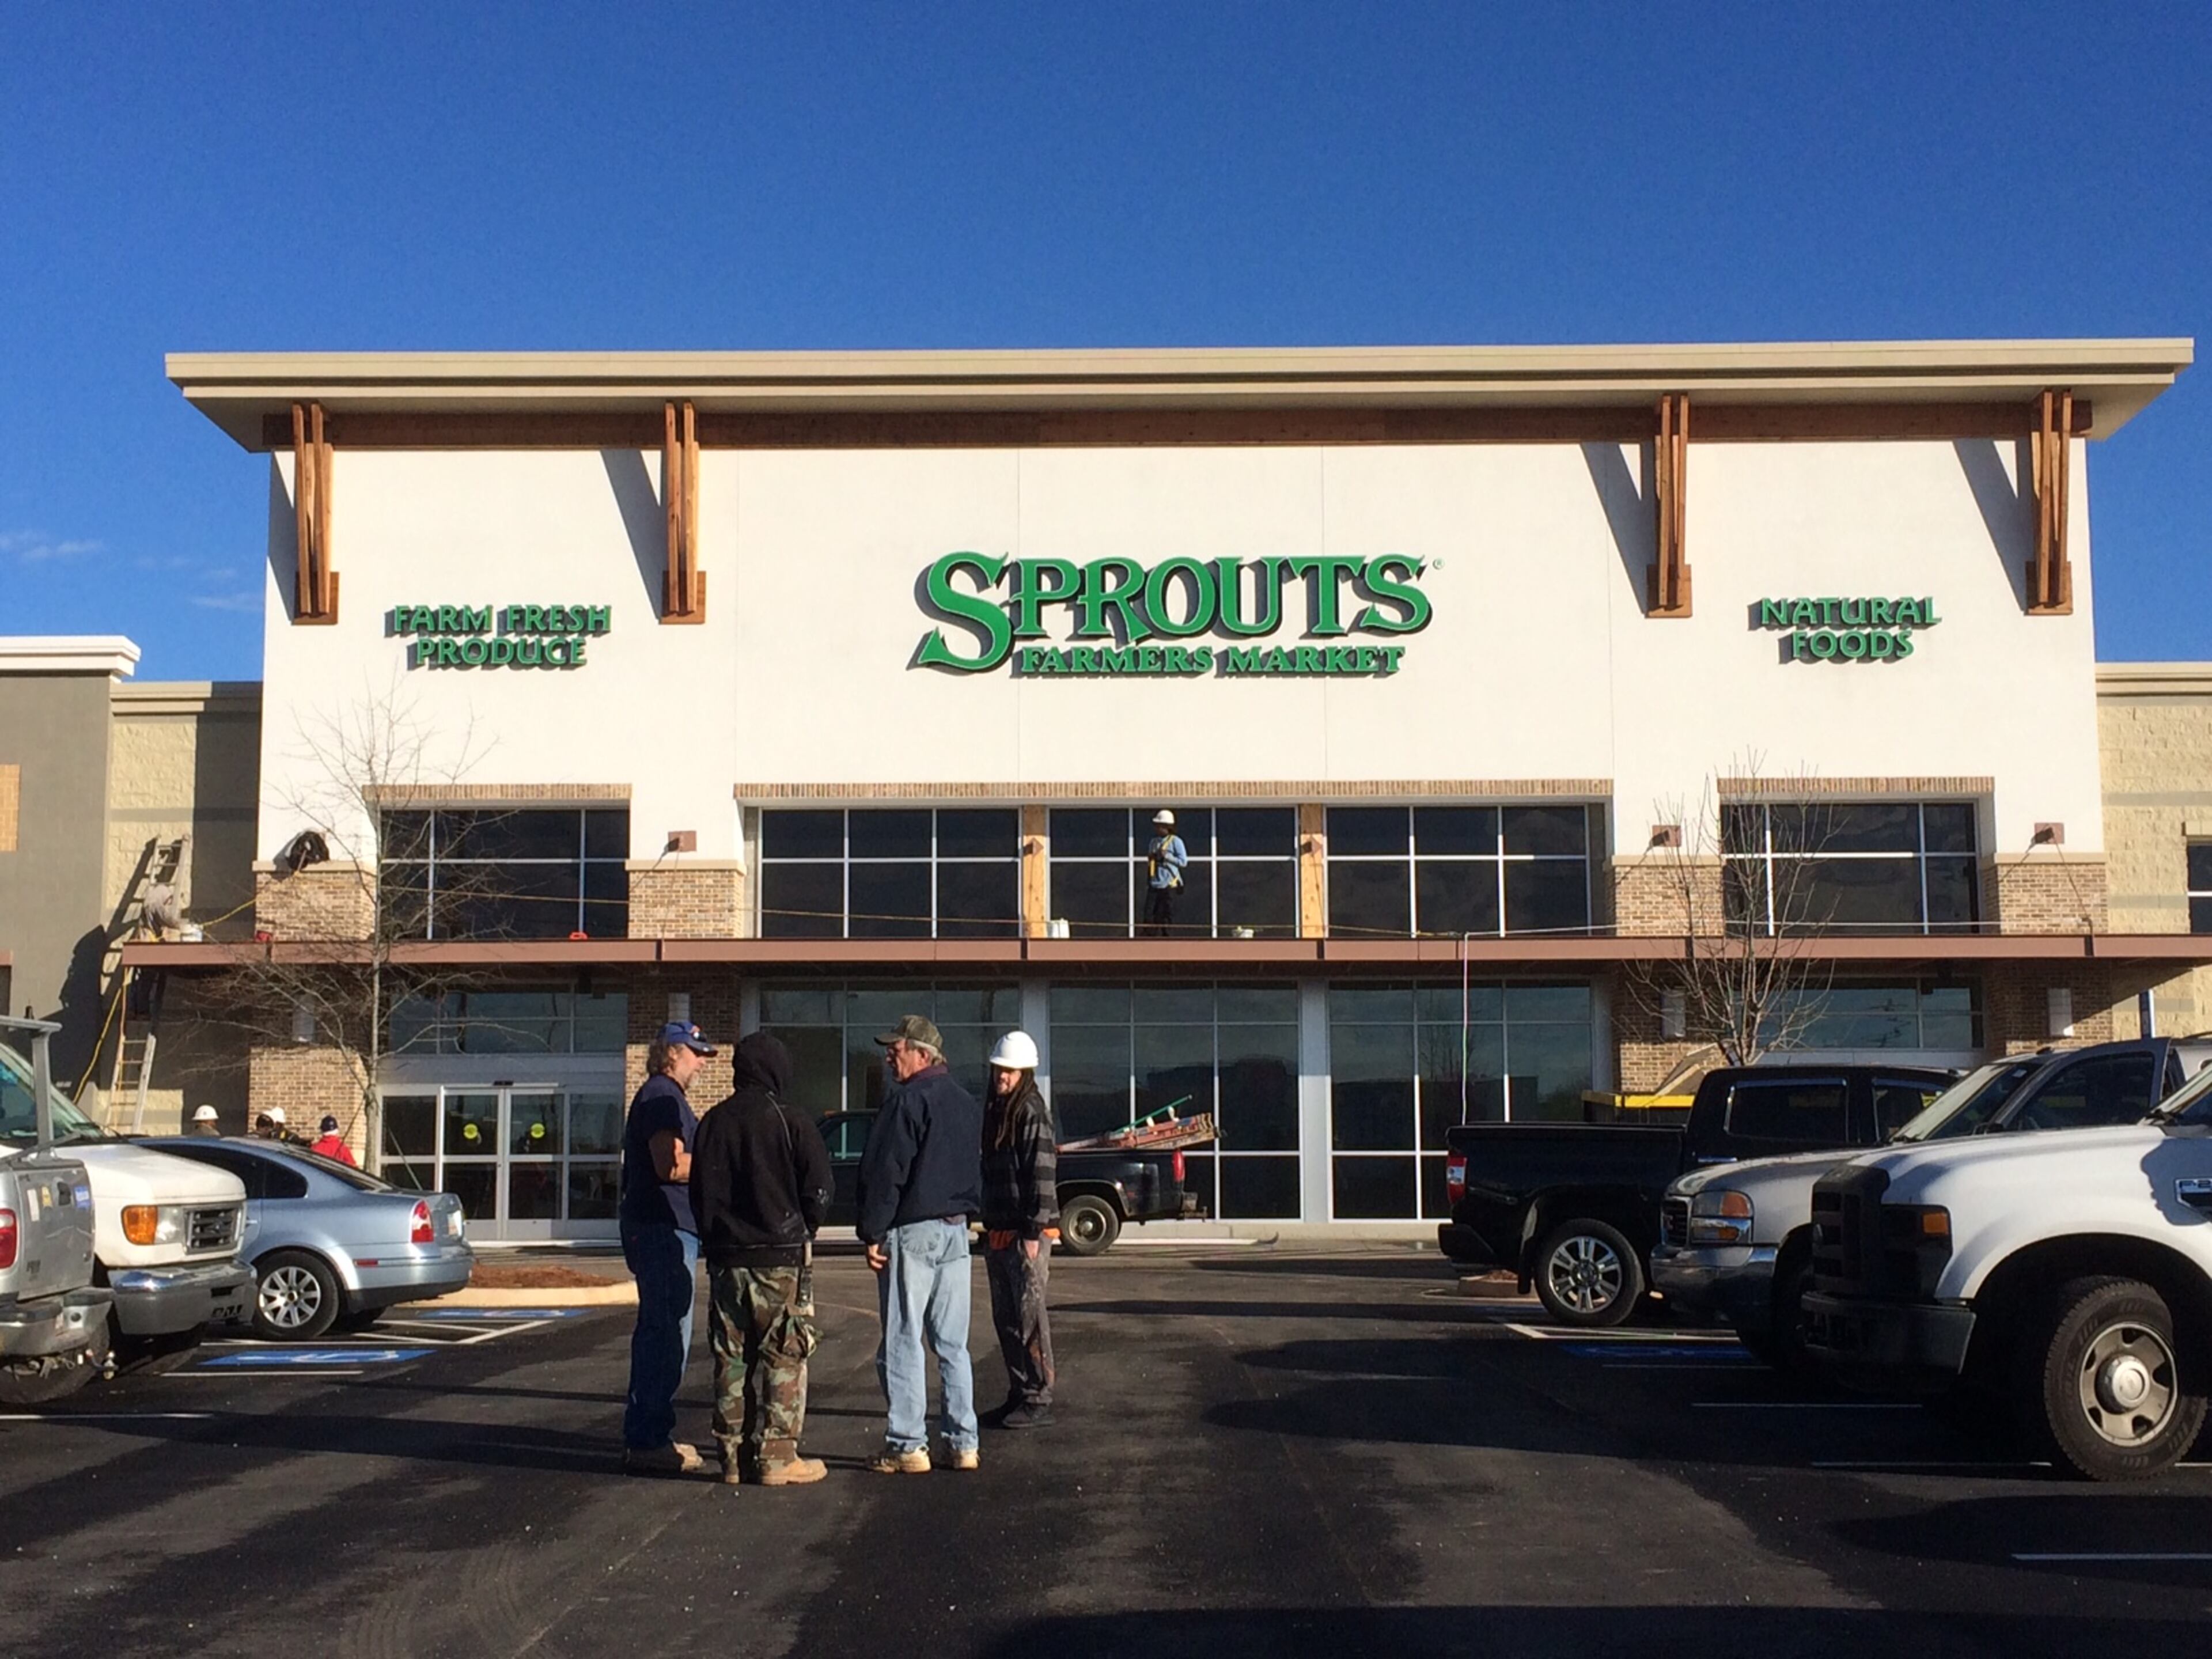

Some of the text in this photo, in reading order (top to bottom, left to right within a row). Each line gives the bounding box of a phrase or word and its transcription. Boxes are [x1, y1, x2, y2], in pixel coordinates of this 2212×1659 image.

[394, 604, 612, 632] FARM FRESH
[918, 551, 1431, 670] SPROUTS
[1761, 596, 1942, 625] NATURAL
[416, 637, 587, 665] PRODUCE
[1792, 630, 1914, 658] FOODS
[1020, 646, 1406, 673] FARMERS MARKET
